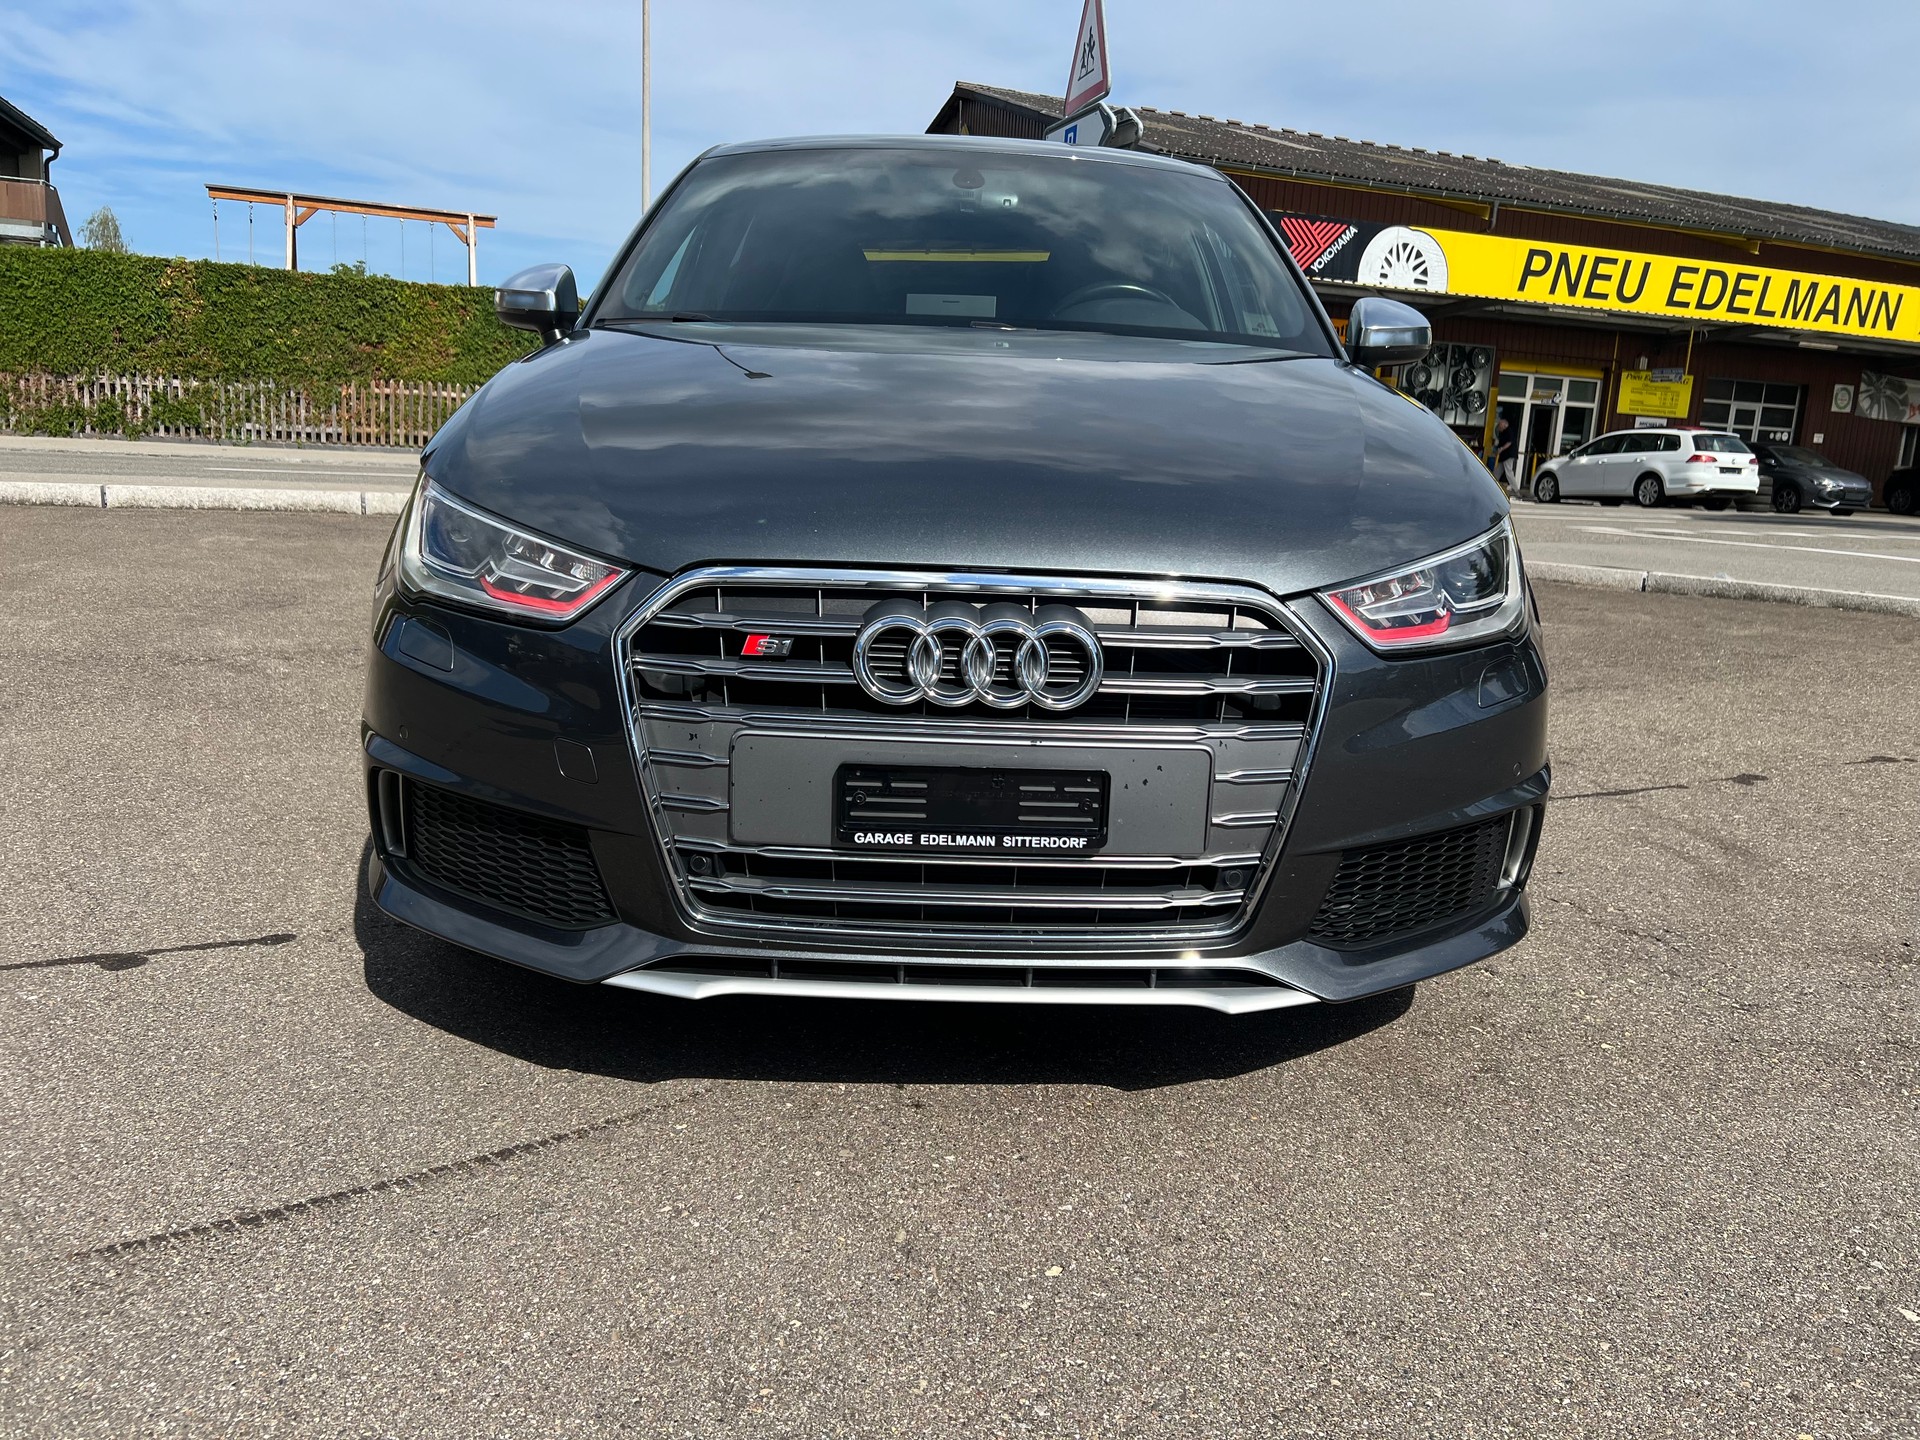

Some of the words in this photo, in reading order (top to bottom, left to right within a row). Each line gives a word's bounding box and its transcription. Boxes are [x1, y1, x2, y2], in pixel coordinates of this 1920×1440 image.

[1310, 225, 1358, 273] YOKOHAMA
[1517, 248, 1652, 304] PNEU
[1665, 265, 1904, 331] EDELMANN
[756, 639, 792, 654] S1
[854, 832, 913, 845] GARAGE
[920, 834, 996, 847] EDELMANN
[1002, 836, 1088, 849] SITTERDORF
